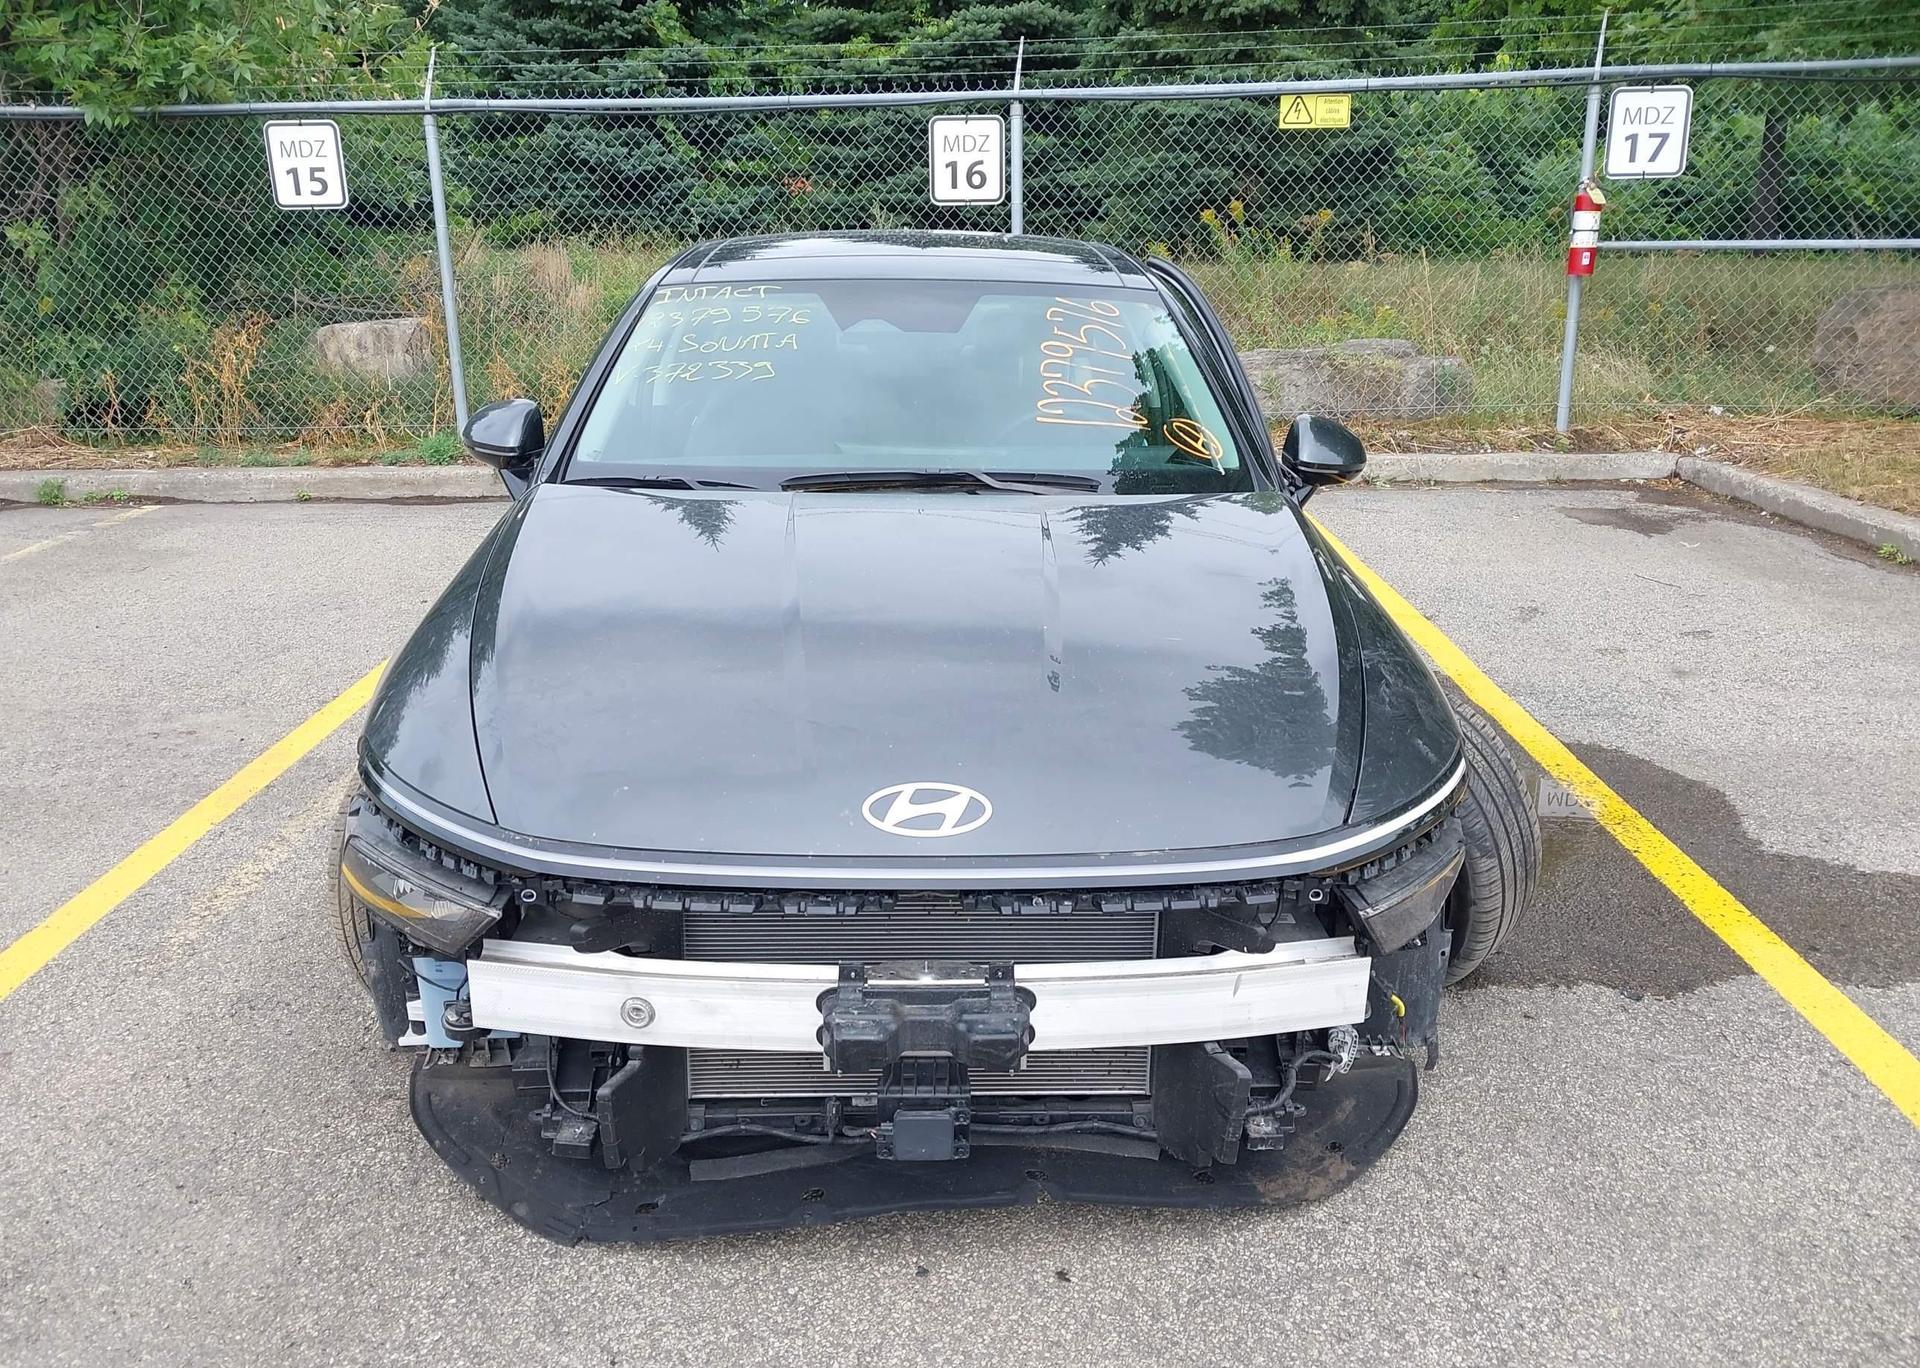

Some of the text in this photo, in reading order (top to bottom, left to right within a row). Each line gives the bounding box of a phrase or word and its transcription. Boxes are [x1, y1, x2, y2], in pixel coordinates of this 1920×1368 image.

[1623, 106, 1676, 126] MDZ
[279, 139, 328, 159] MDZ
[943, 134, 992, 153] MDZ
[1624, 132, 1671, 164] 17
[285, 166, 329, 197] 15
[945, 159, 988, 190] 16
[655, 285, 783, 305] INTACT
